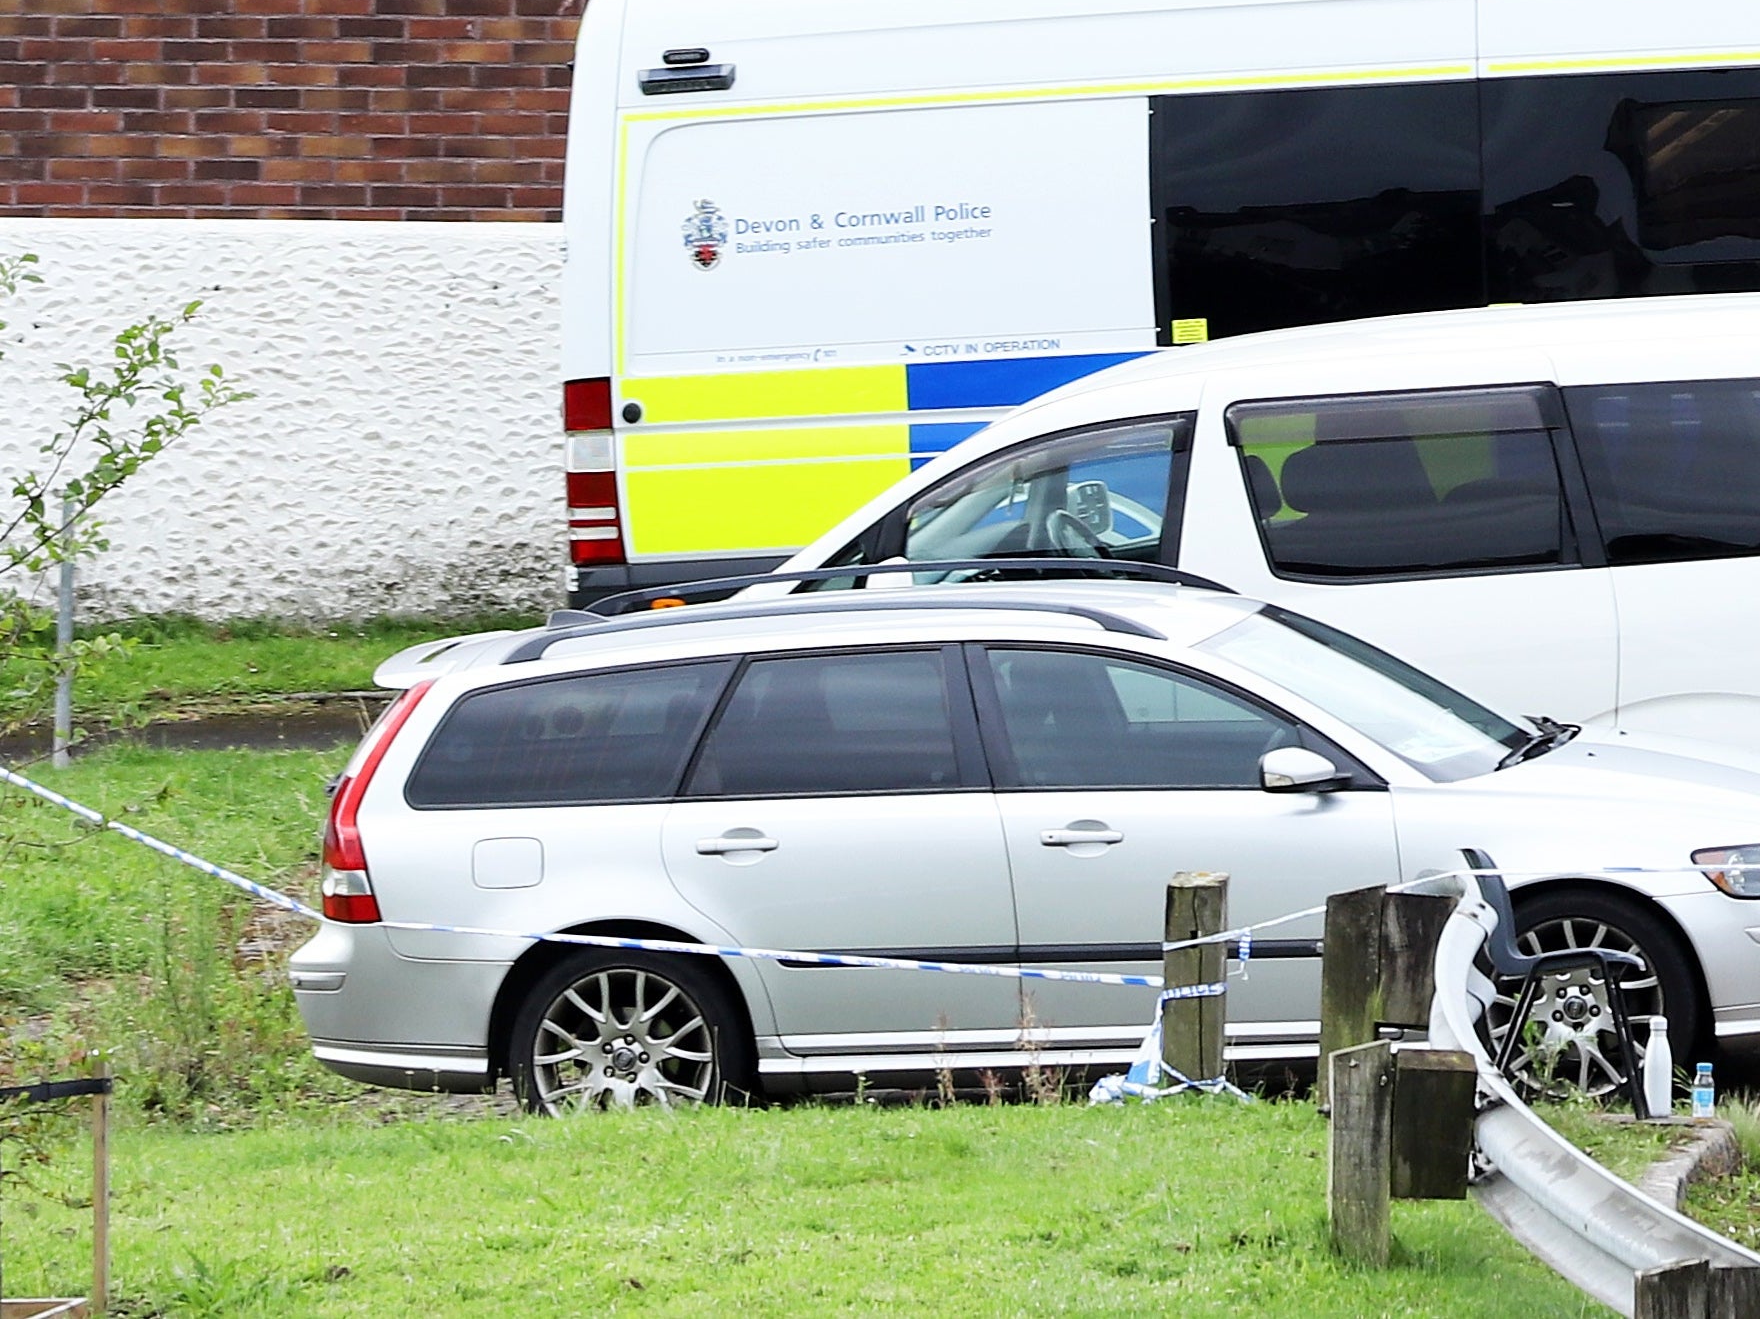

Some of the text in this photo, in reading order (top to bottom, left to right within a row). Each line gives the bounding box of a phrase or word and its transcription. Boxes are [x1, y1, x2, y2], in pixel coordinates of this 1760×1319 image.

[734, 202, 992, 235] Devon & Cornwall Police
[736, 227, 992, 254] Building safer communities together
[923, 338, 1062, 357] CCTV IN OPERATION
